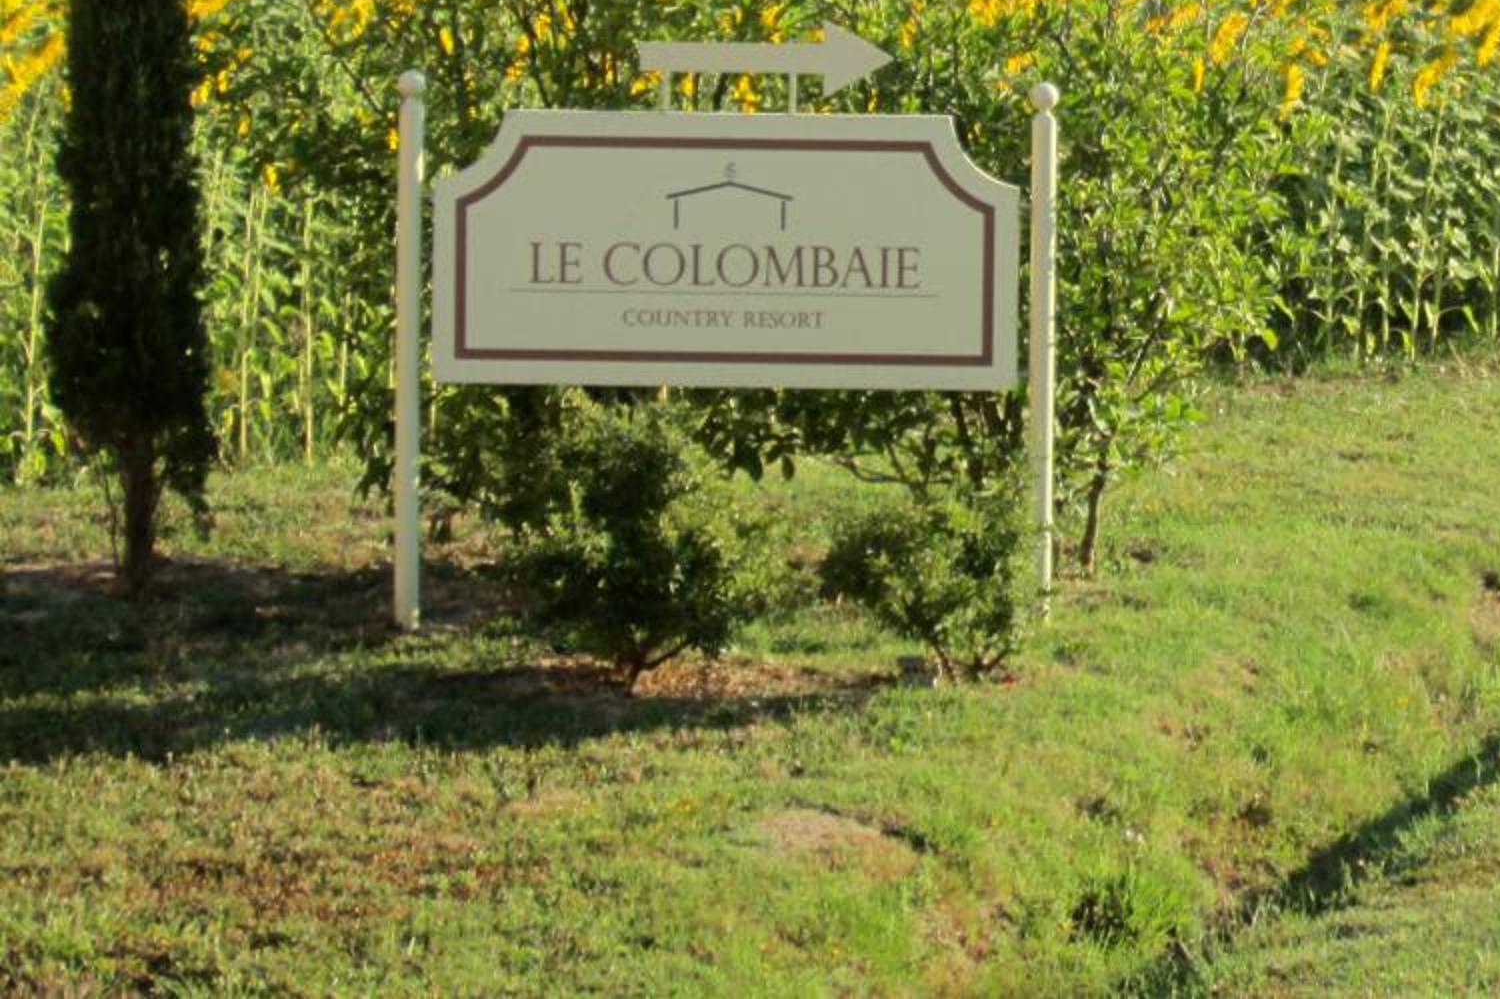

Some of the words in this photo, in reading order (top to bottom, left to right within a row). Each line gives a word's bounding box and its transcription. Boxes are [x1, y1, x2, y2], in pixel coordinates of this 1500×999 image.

[529, 242, 583, 285] LE
[602, 242, 922, 289] COLOMBAIE
[623, 309, 735, 329] COUNTRY
[744, 311, 825, 330] RESORT
